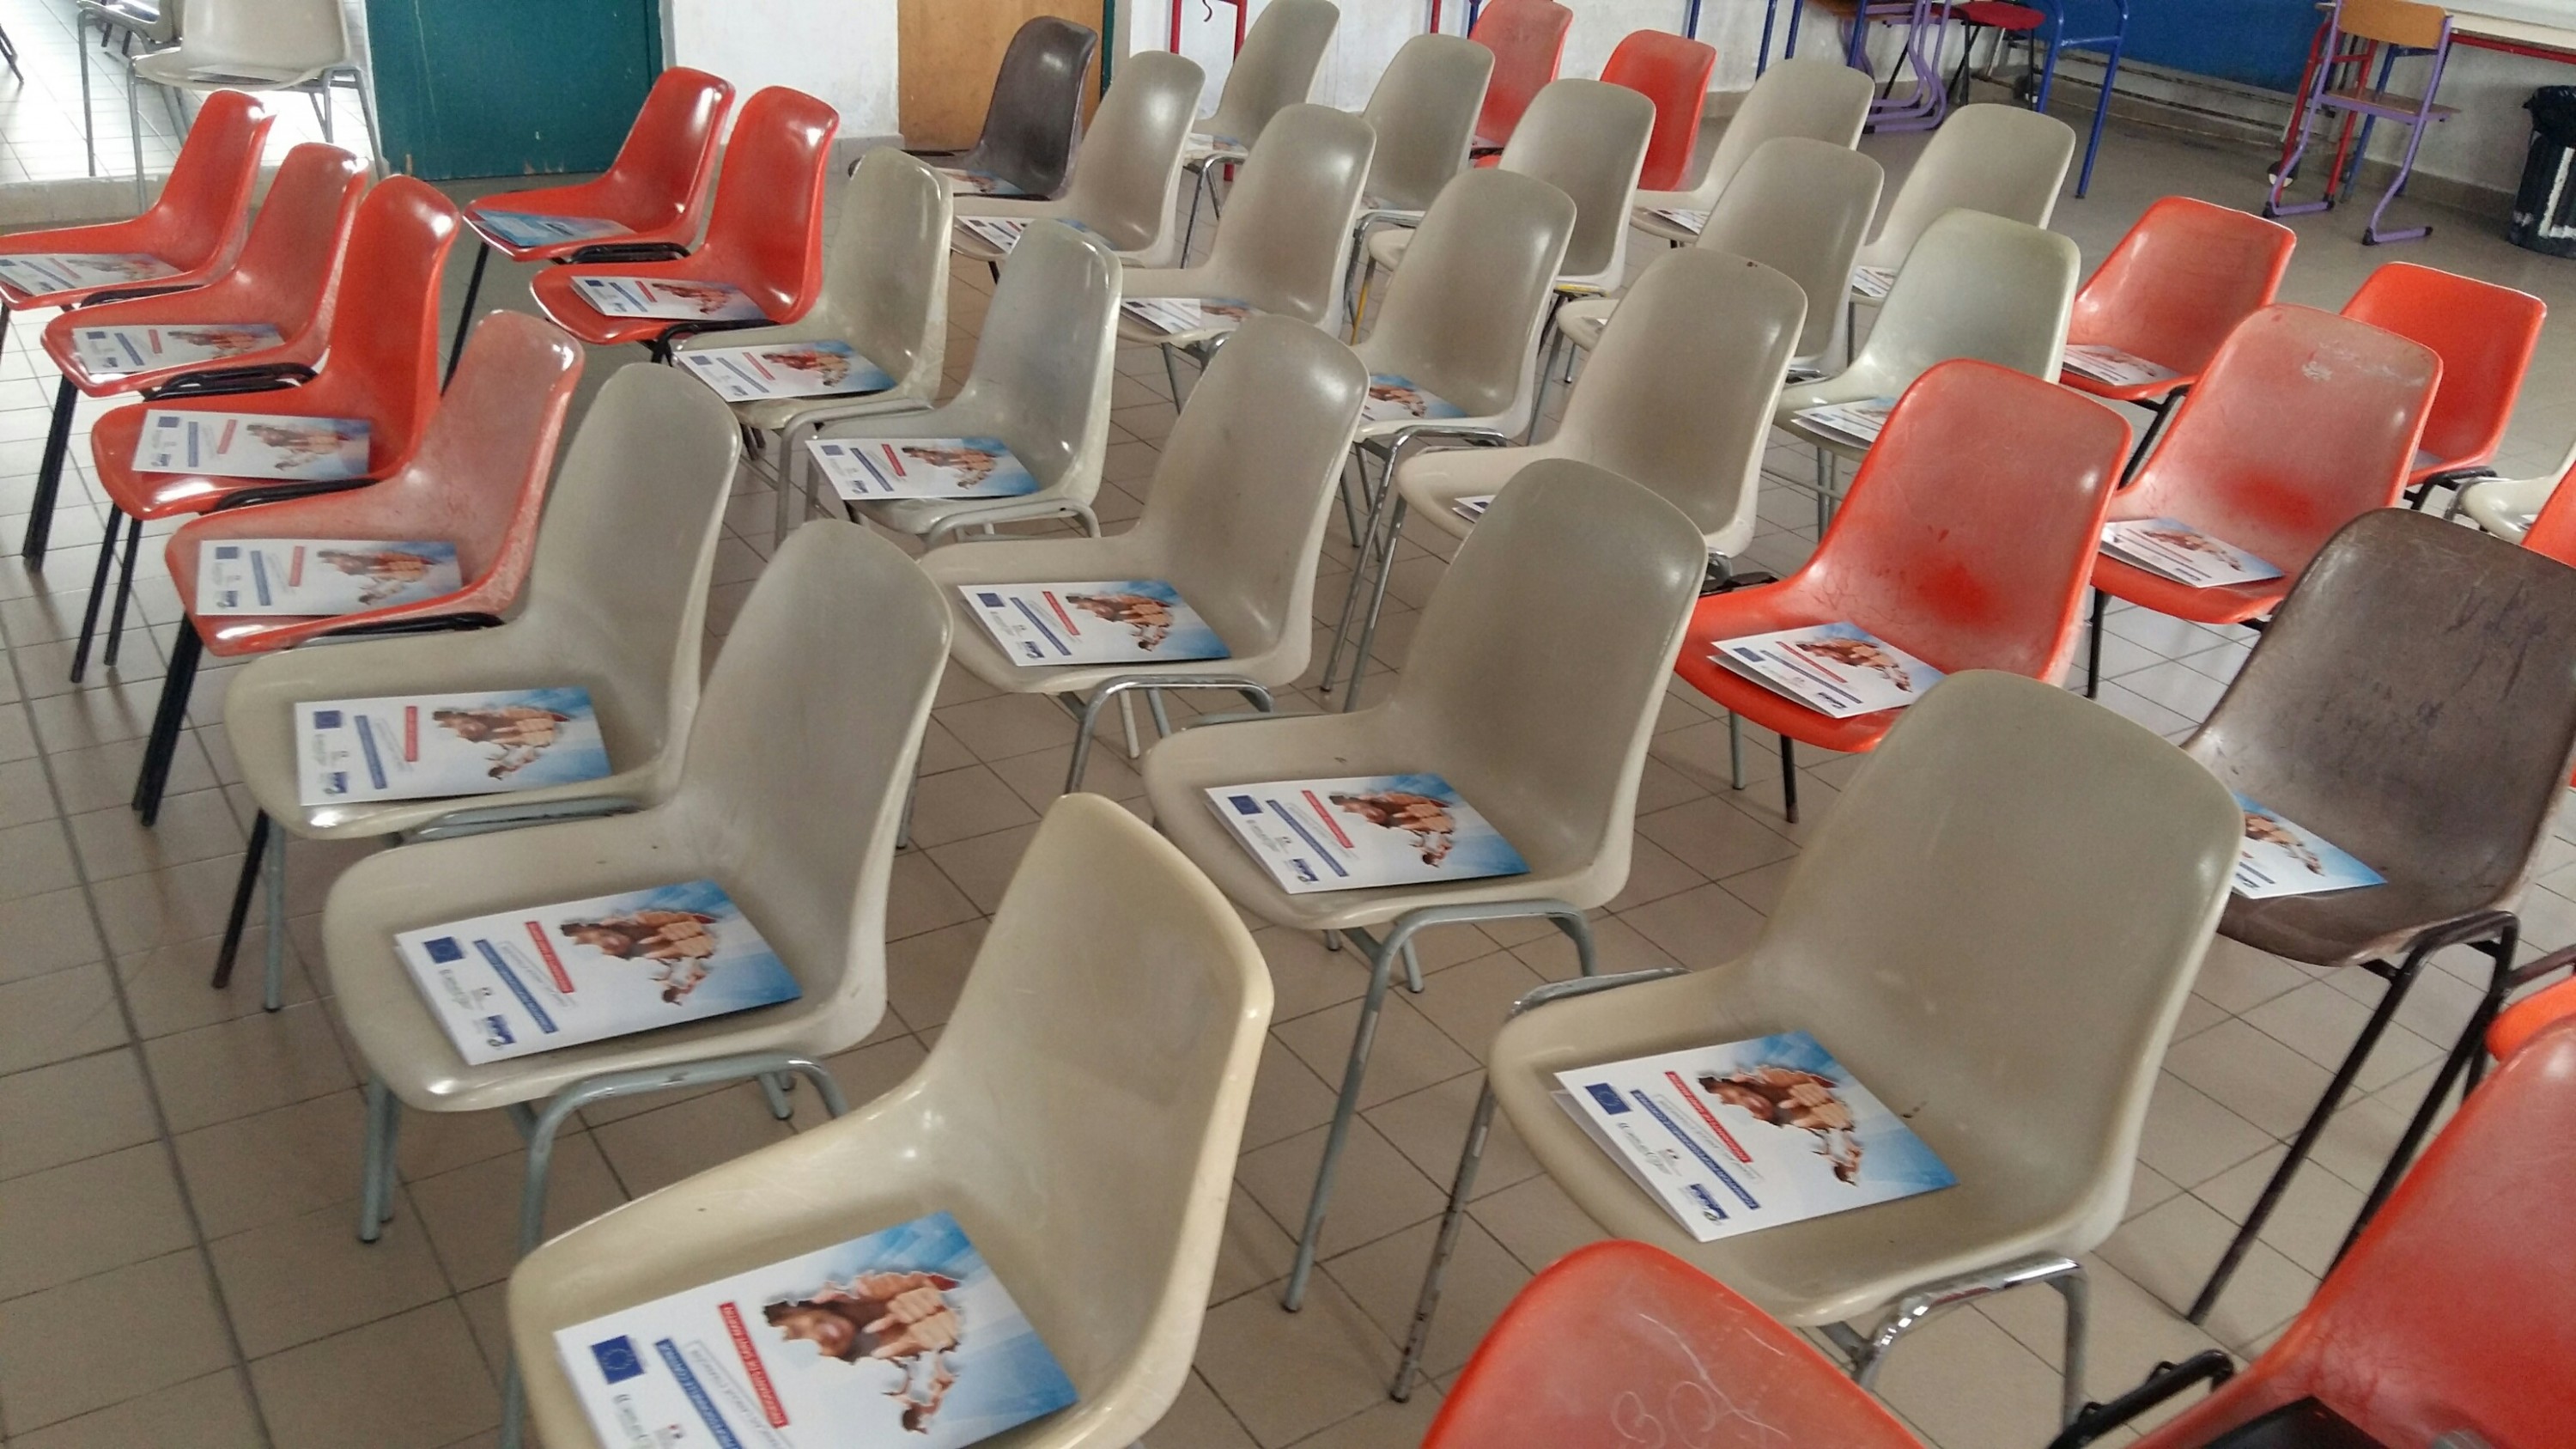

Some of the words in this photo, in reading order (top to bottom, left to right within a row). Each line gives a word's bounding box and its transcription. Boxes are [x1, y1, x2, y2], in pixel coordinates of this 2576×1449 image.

[720, 1305, 745, 1336] MARTIN
[735, 1336, 756, 1360] SAINT
[751, 1370, 785, 1424] ENSEIGNANTS
